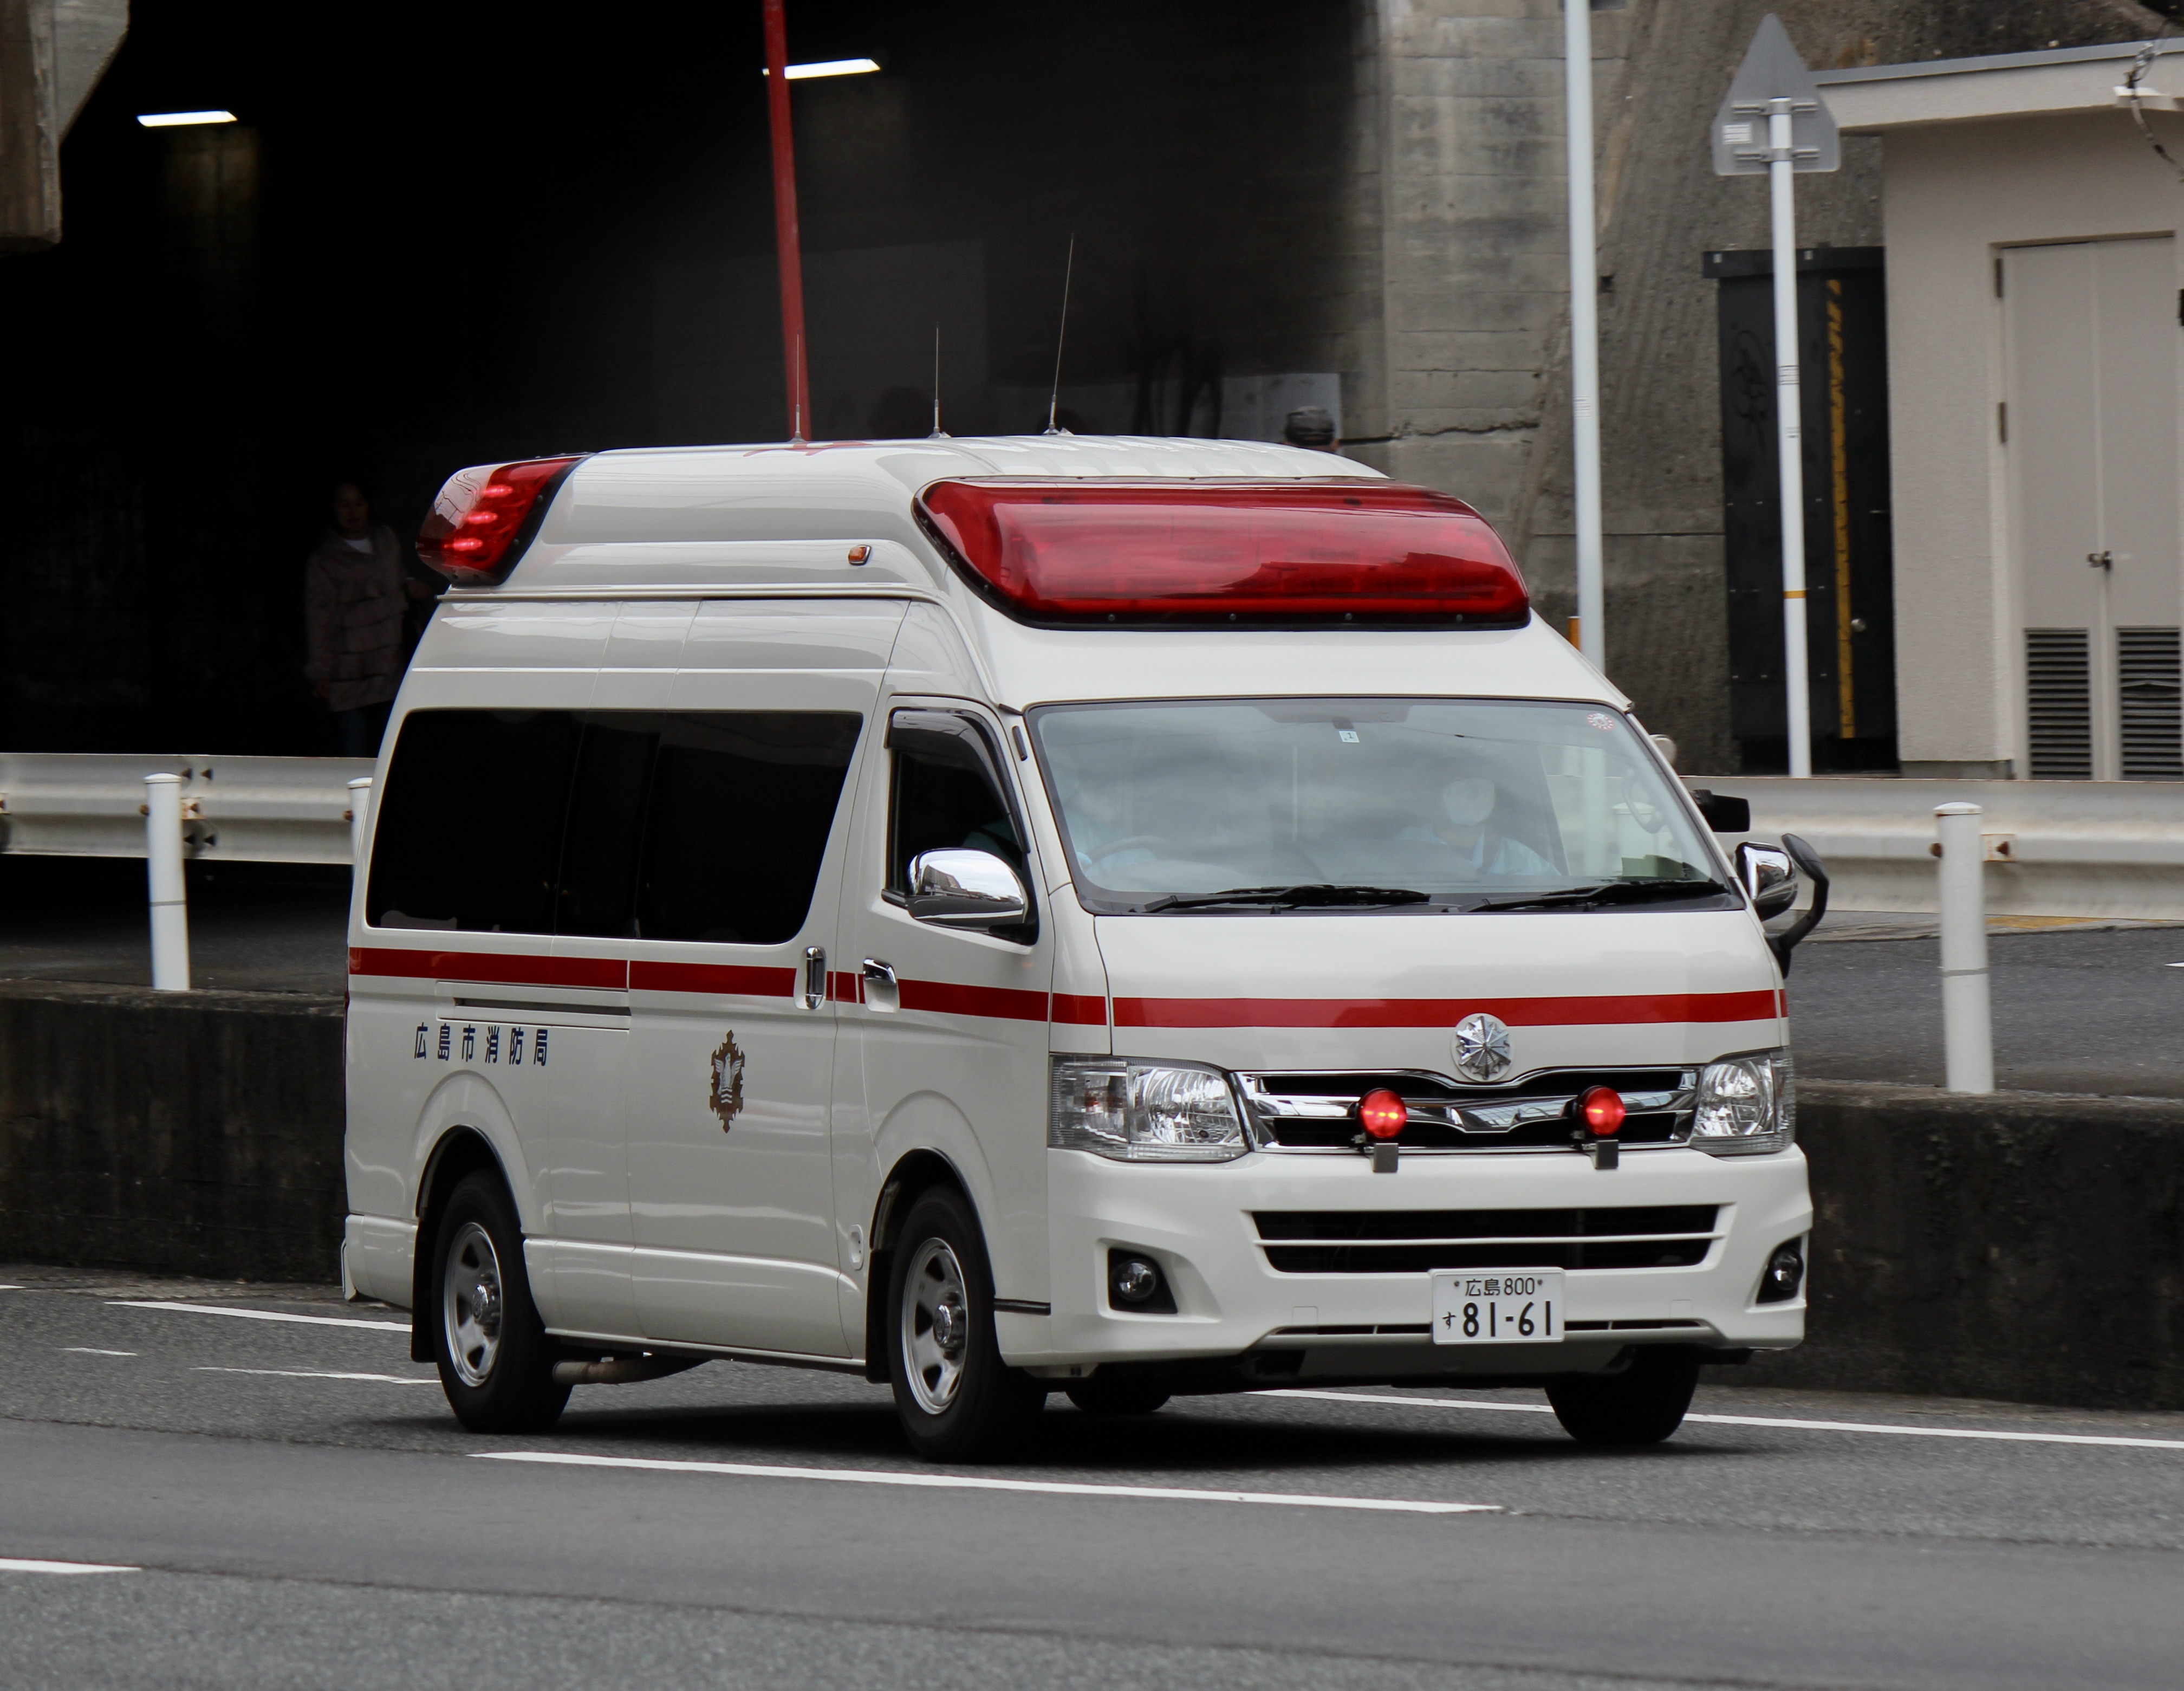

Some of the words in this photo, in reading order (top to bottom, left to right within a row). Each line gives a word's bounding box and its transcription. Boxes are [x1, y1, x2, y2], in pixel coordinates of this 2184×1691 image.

[414, 1022, 548, 1066] 広島市消防局
[1465, 1278, 1500, 1297] 広島
[1504, 1277, 1535, 1296] 800
[1442, 1311, 1457, 1330] す
[1463, 1300, 1551, 1338] 81-61
